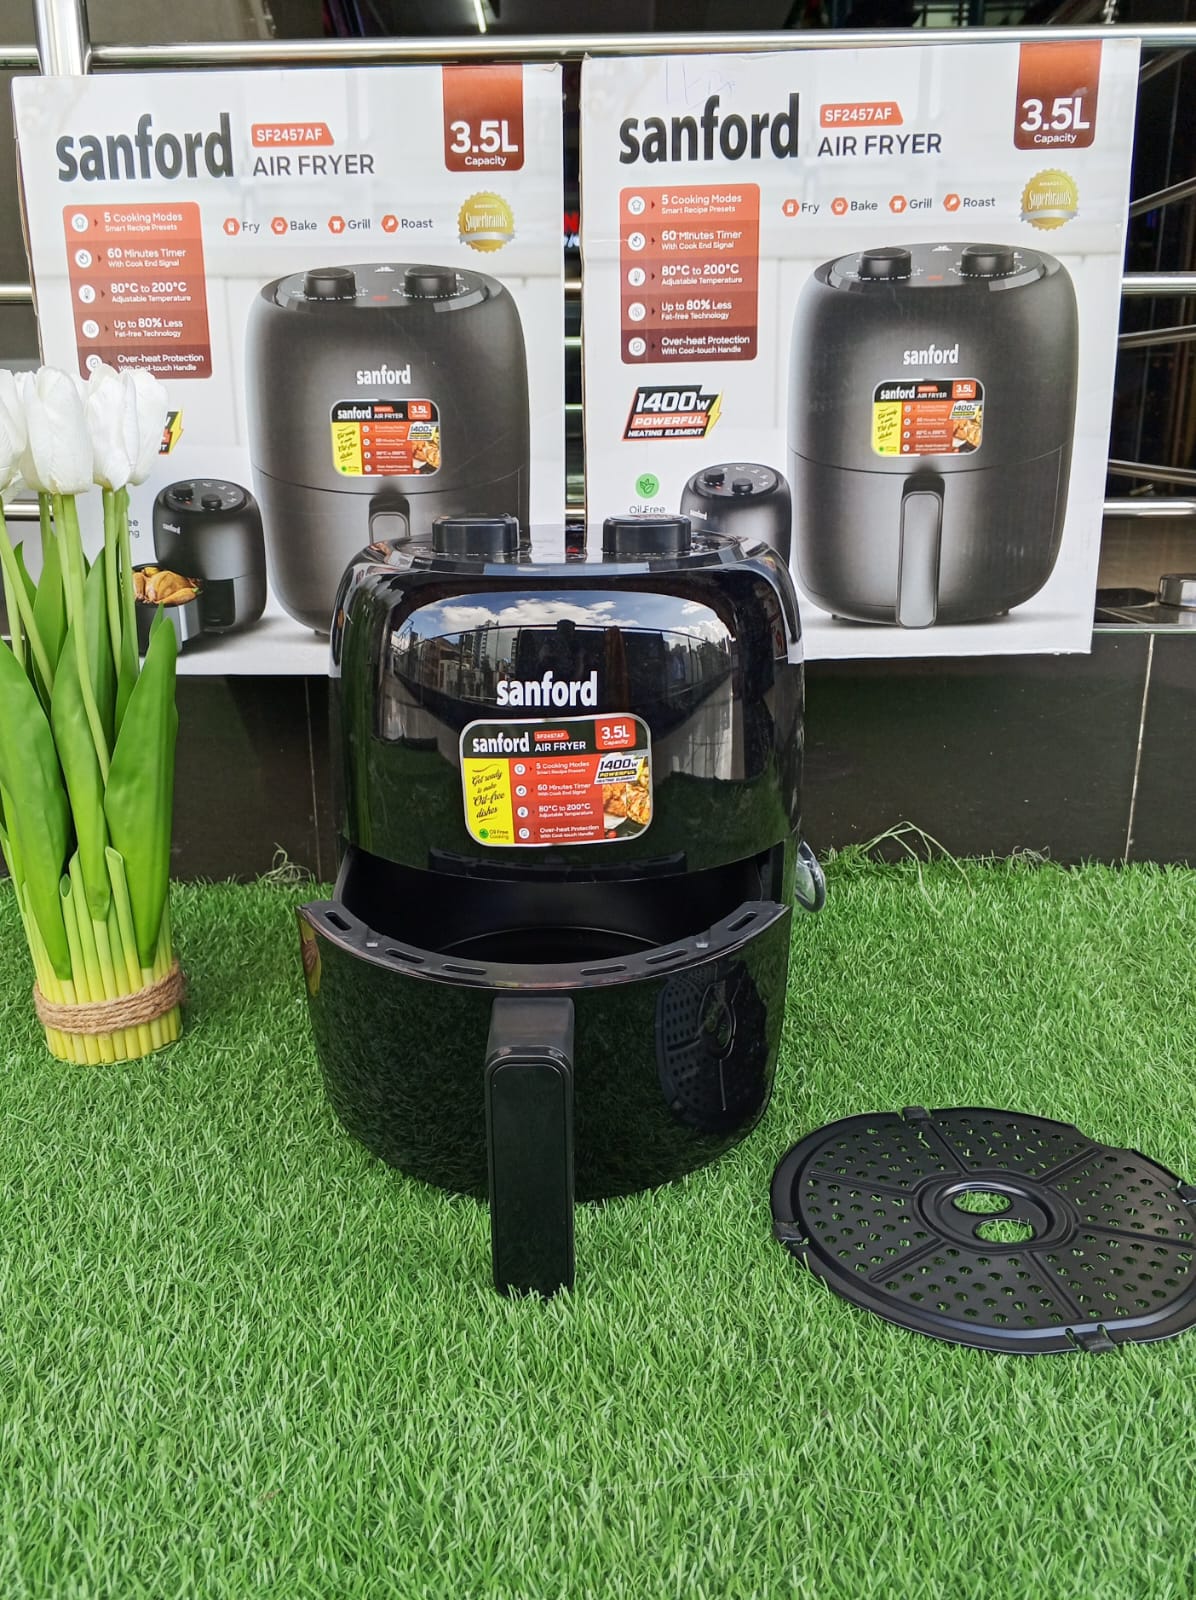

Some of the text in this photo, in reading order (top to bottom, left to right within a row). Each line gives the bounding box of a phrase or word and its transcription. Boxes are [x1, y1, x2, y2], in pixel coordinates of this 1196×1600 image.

[824, 108, 892, 122] SF2457AF
[1020, 97, 1090, 132] 3.5L
[619, 93, 800, 165] sanford
[256, 128, 323, 142] SF2457AF
[450, 120, 519, 154] 3.5L
[1033, 133, 1077, 144] Capacity
[56, 112, 234, 182] sanford
[817, 133, 942, 157] AIR FRYER
[253, 154, 375, 176] AIR FRYER
[464, 155, 507, 167] Capacity
[661, 194, 742, 205] 5 Cooking Modes
[909, 198, 933, 209] Grill
[963, 197, 996, 208] Roast
[684, 206, 708, 214] Recipe
[709, 205, 736, 213] Presets
[801, 202, 820, 216] Fry
[850, 200, 878, 211] Bake
[104, 212, 183, 224] 5 Cooking Modes
[401, 218, 433, 229] Roast
[127, 224, 150, 233] Recipe
[242, 221, 260, 235] Fry
[290, 220, 317, 232] Bake
[348, 219, 371, 230] Grill
[661, 230, 742, 241] 60 Minutes Timer
[661, 241, 734, 250] With Cook End Signal
[107, 248, 186, 258] 60 Minutes Timer
[108, 260, 124, 268] With
[158, 259, 180, 268] Signal
[661, 263, 739, 276] 80°C to 200°C
[661, 276, 743, 286] Adjustable Temperature
[111, 282, 187, 293] 80°C to 200°C
[112, 295, 191, 304] Adjustable Temperature
[661, 299, 732, 312] Up to 80% Less
[690, 311, 729, 320] Technology
[114, 318, 183, 330] Up to 80% Less
[142, 329, 181, 338] Technology
[661, 335, 750, 346] Over-heat Protection
[661, 345, 741, 355] With Cool-touch Handle
[903, 343, 959, 365] sanford
[117, 353, 204, 363] Over-heat Protection
[356, 364, 411, 385] sanford
[880, 386, 915, 399] sanford
[956, 384, 973, 393] 3.5L
[337, 406, 372, 419] sanford
[411, 405, 428, 414] 3.5L
[635, 415, 704, 426] POWERFUL
[628, 428, 704, 437] HEATING ELEMENT
[645, 505, 666, 513] Free
[496, 670, 598, 707] sanford
[601, 725, 630, 739] 3.5L
[472, 731, 530, 753] sanford
[534, 741, 586, 752] AIR FRYER
[472, 769, 502, 786] Get ready
[476, 805, 498, 819] dishes
[538, 804, 557, 812] 80°C
[570, 824, 600, 832] Protection
